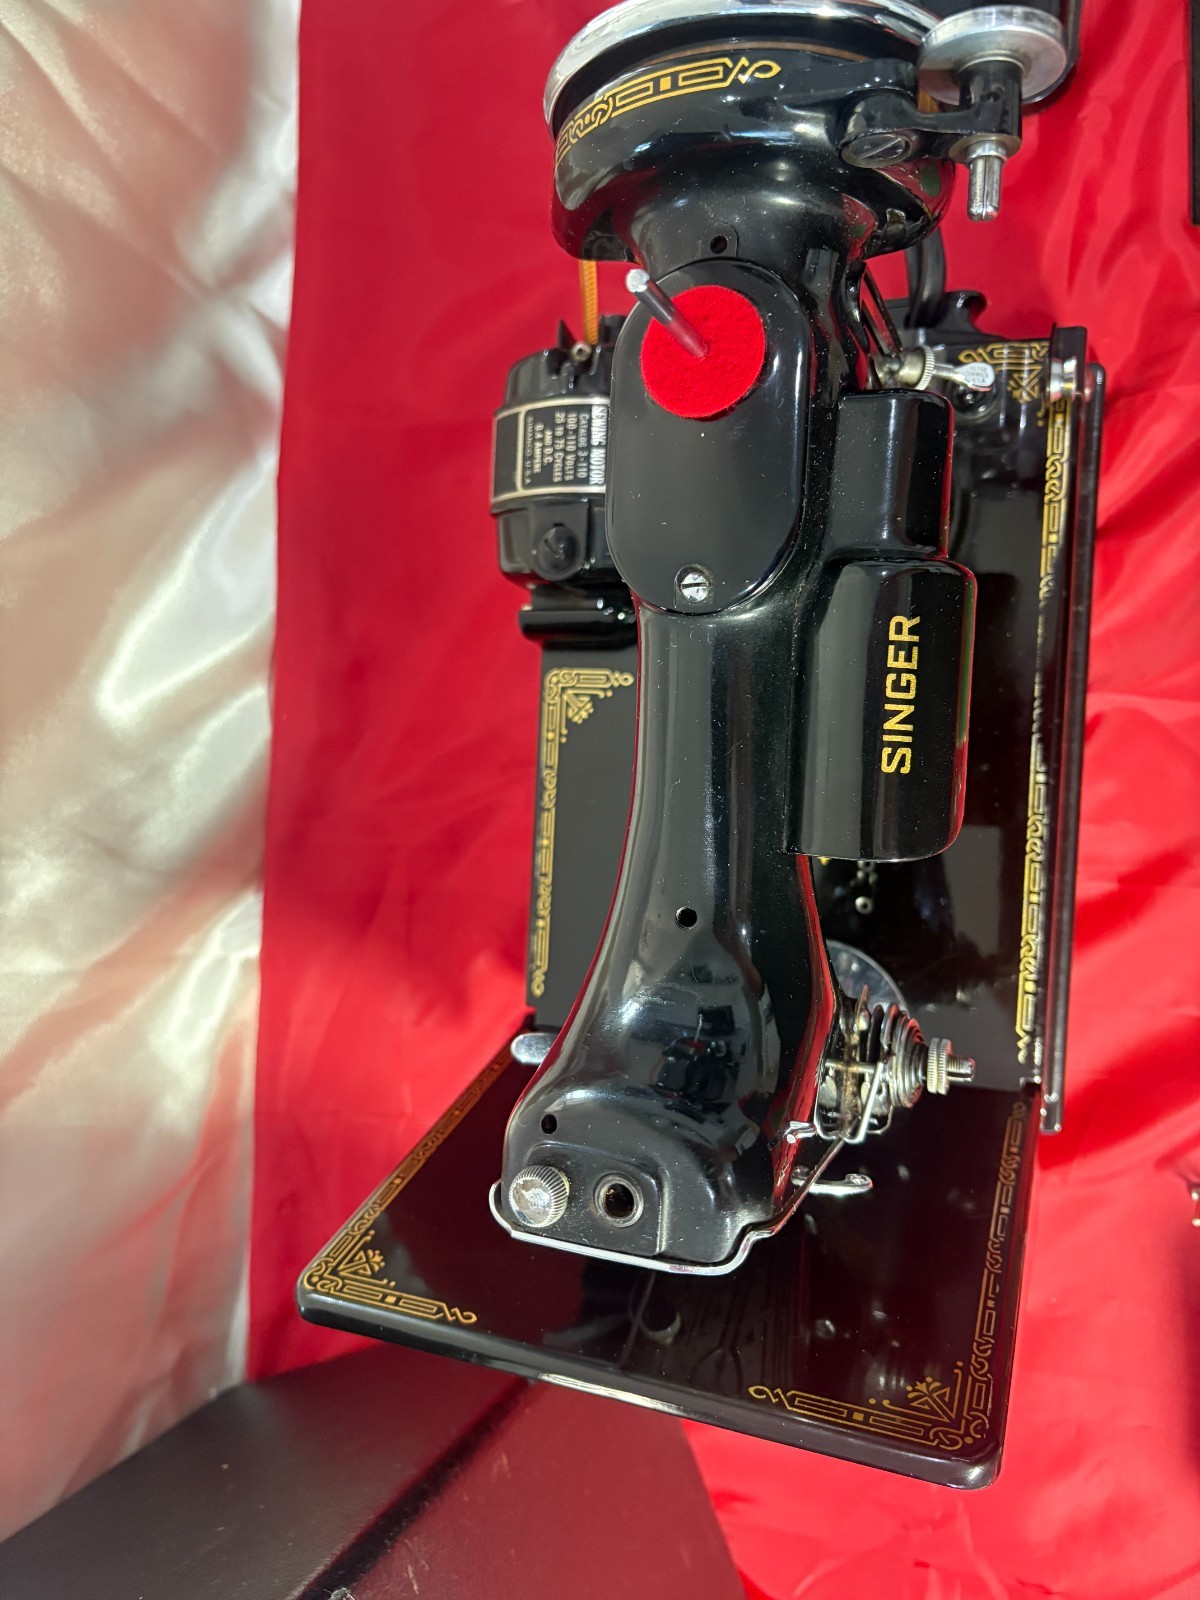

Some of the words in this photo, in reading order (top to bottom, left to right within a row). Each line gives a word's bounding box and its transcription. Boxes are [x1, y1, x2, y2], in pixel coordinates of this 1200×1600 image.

[555, 411, 566, 424] 25
[555, 426, 565, 436] TO
[590, 405, 607, 446] SEWING
[544, 430, 553, 446] AND
[554, 437, 566, 450] 75
[533, 441, 544, 474] AMPERE
[552, 451, 564, 483] CYCLES
[564, 454, 576, 481] VOLTS
[589, 448, 606, 485] MOTOR
[880, 615, 921, 774] SINGER
